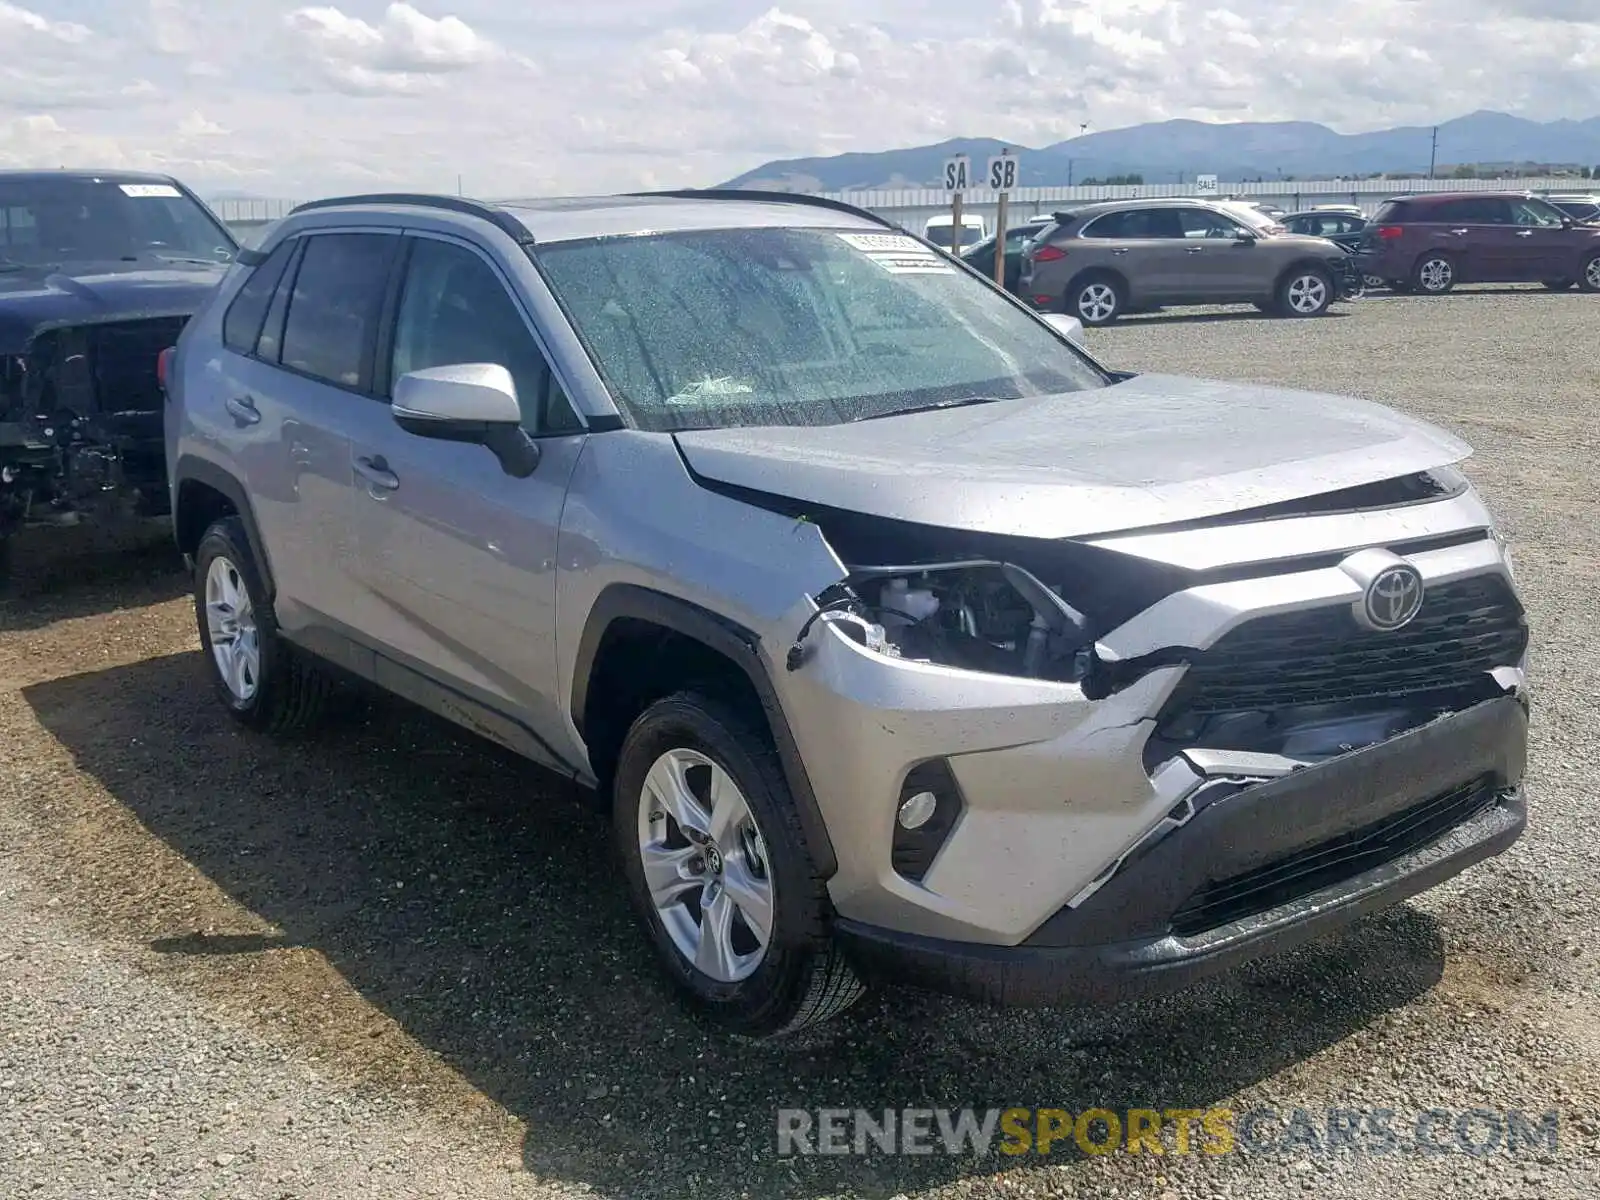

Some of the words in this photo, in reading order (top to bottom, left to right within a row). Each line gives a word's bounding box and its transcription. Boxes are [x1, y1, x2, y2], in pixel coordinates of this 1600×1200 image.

[946, 162, 967, 190] SA
[990, 161, 1016, 189] SB
[1198, 180, 1217, 190] SALE
